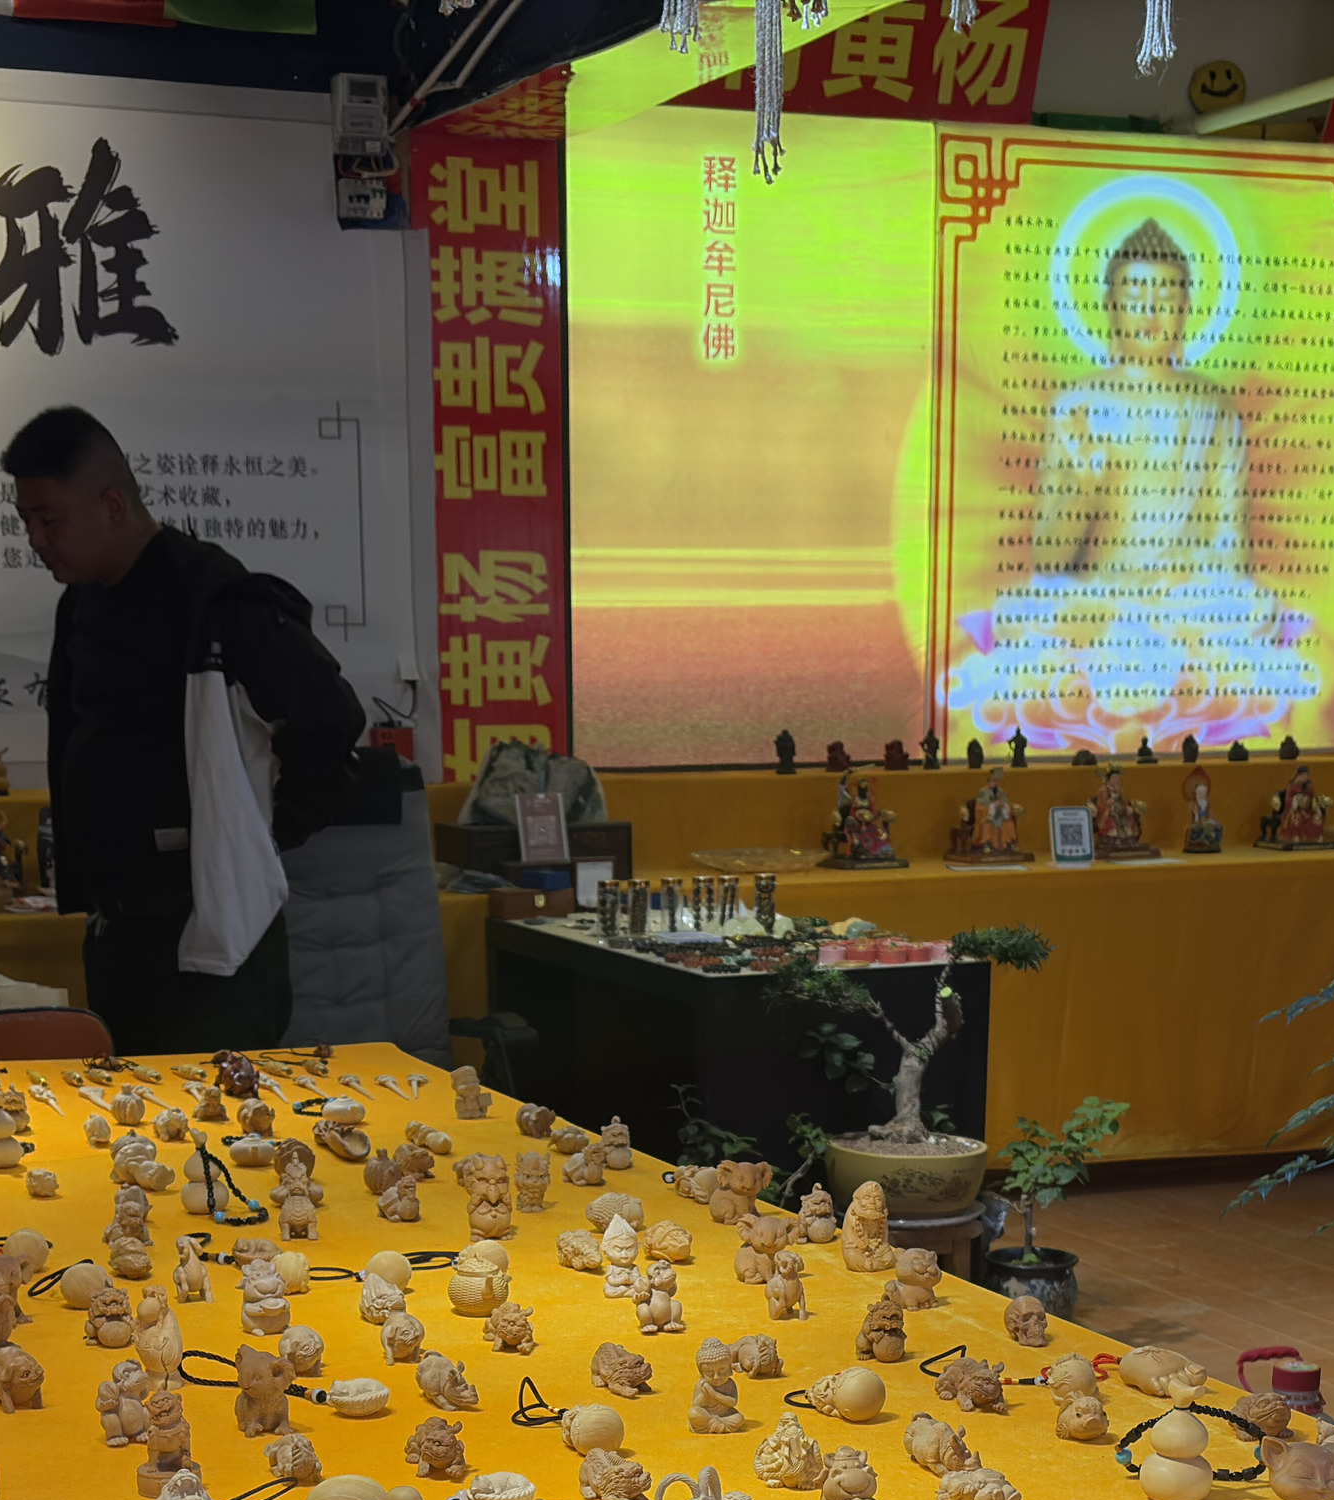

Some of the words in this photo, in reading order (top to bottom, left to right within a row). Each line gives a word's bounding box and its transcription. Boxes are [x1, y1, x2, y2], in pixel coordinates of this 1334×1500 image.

[725, 0, 1028, 105] 黄杨
[428, 155, 548, 499] 富贵满堂
[702, 155, 737, 361] 释迦牟尼佛
